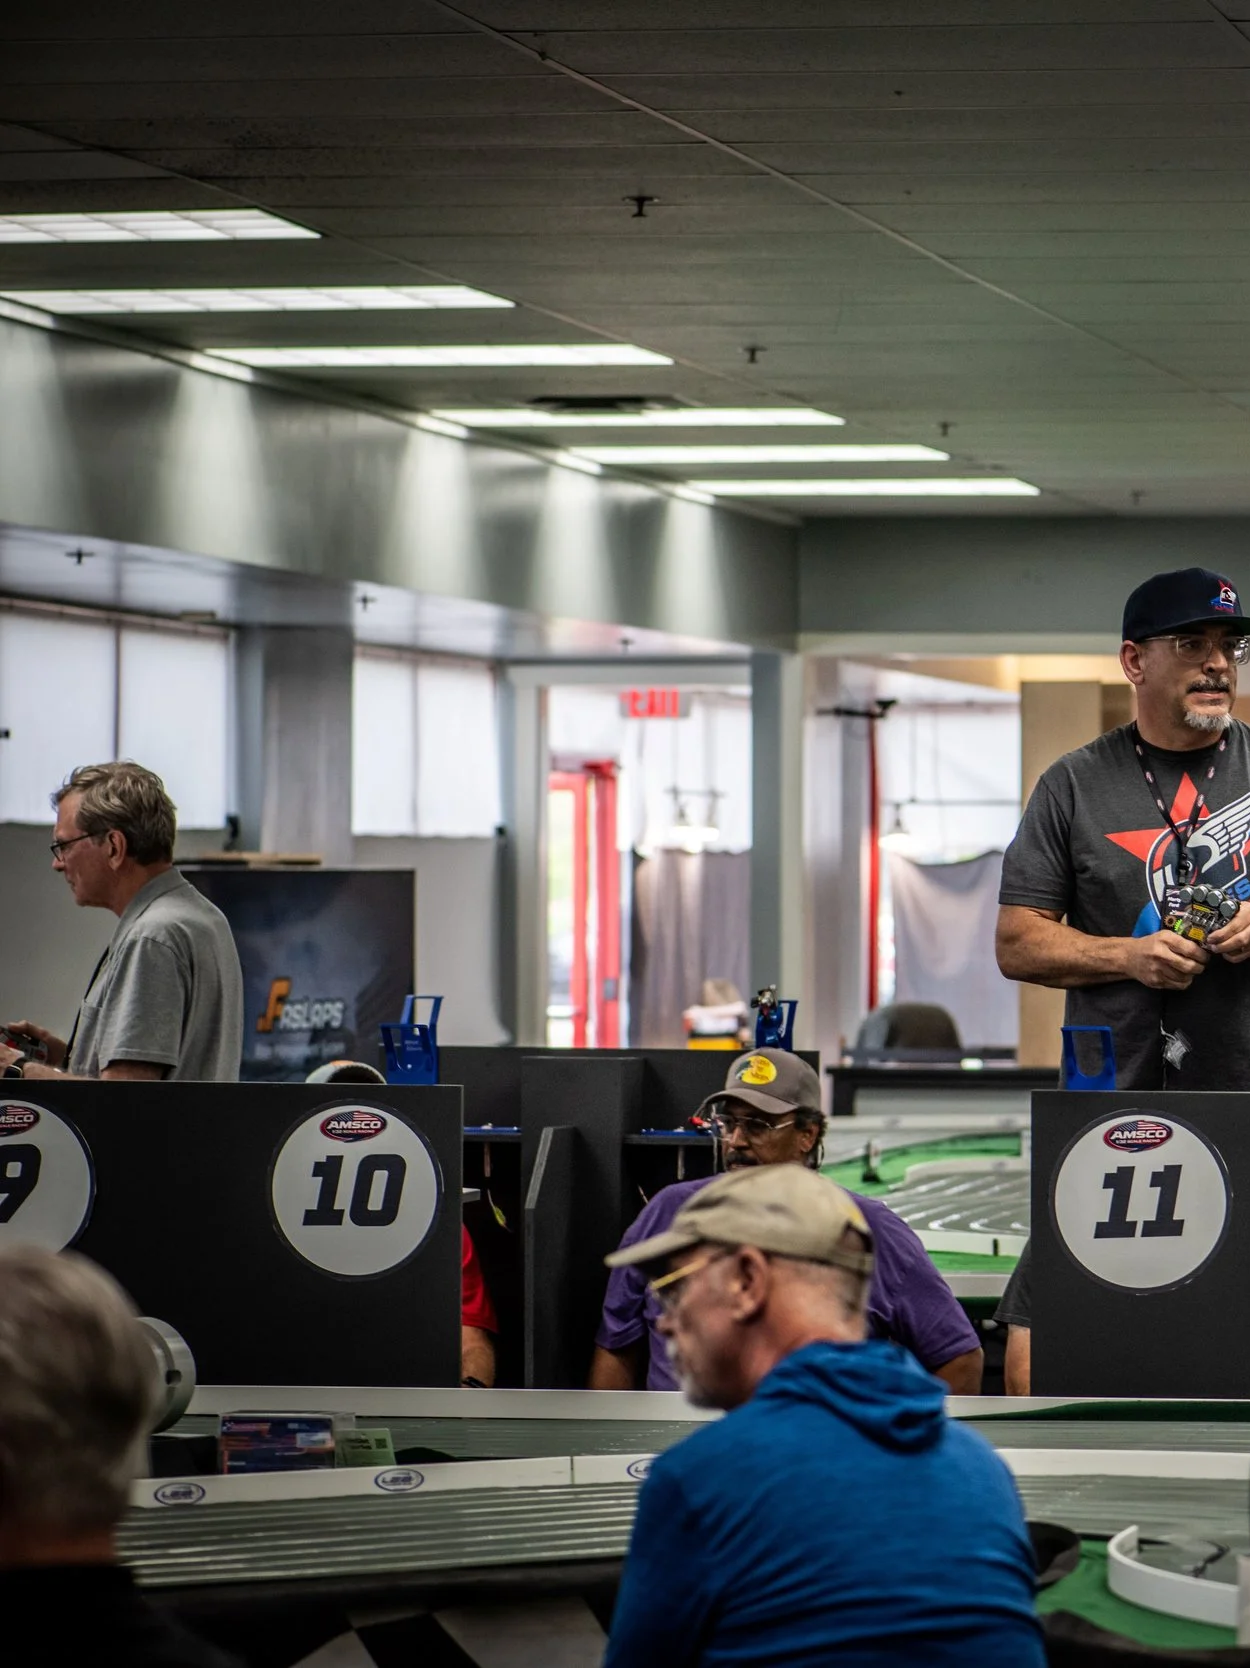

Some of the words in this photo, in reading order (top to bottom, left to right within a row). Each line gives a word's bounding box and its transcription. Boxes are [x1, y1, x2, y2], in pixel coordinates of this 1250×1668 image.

[327, 1120, 382, 1130] AMSCO
[1110, 1129, 1167, 1140] AMSCO
[302, 1153, 407, 1227] 10
[1093, 1164, 1185, 1239] 11
